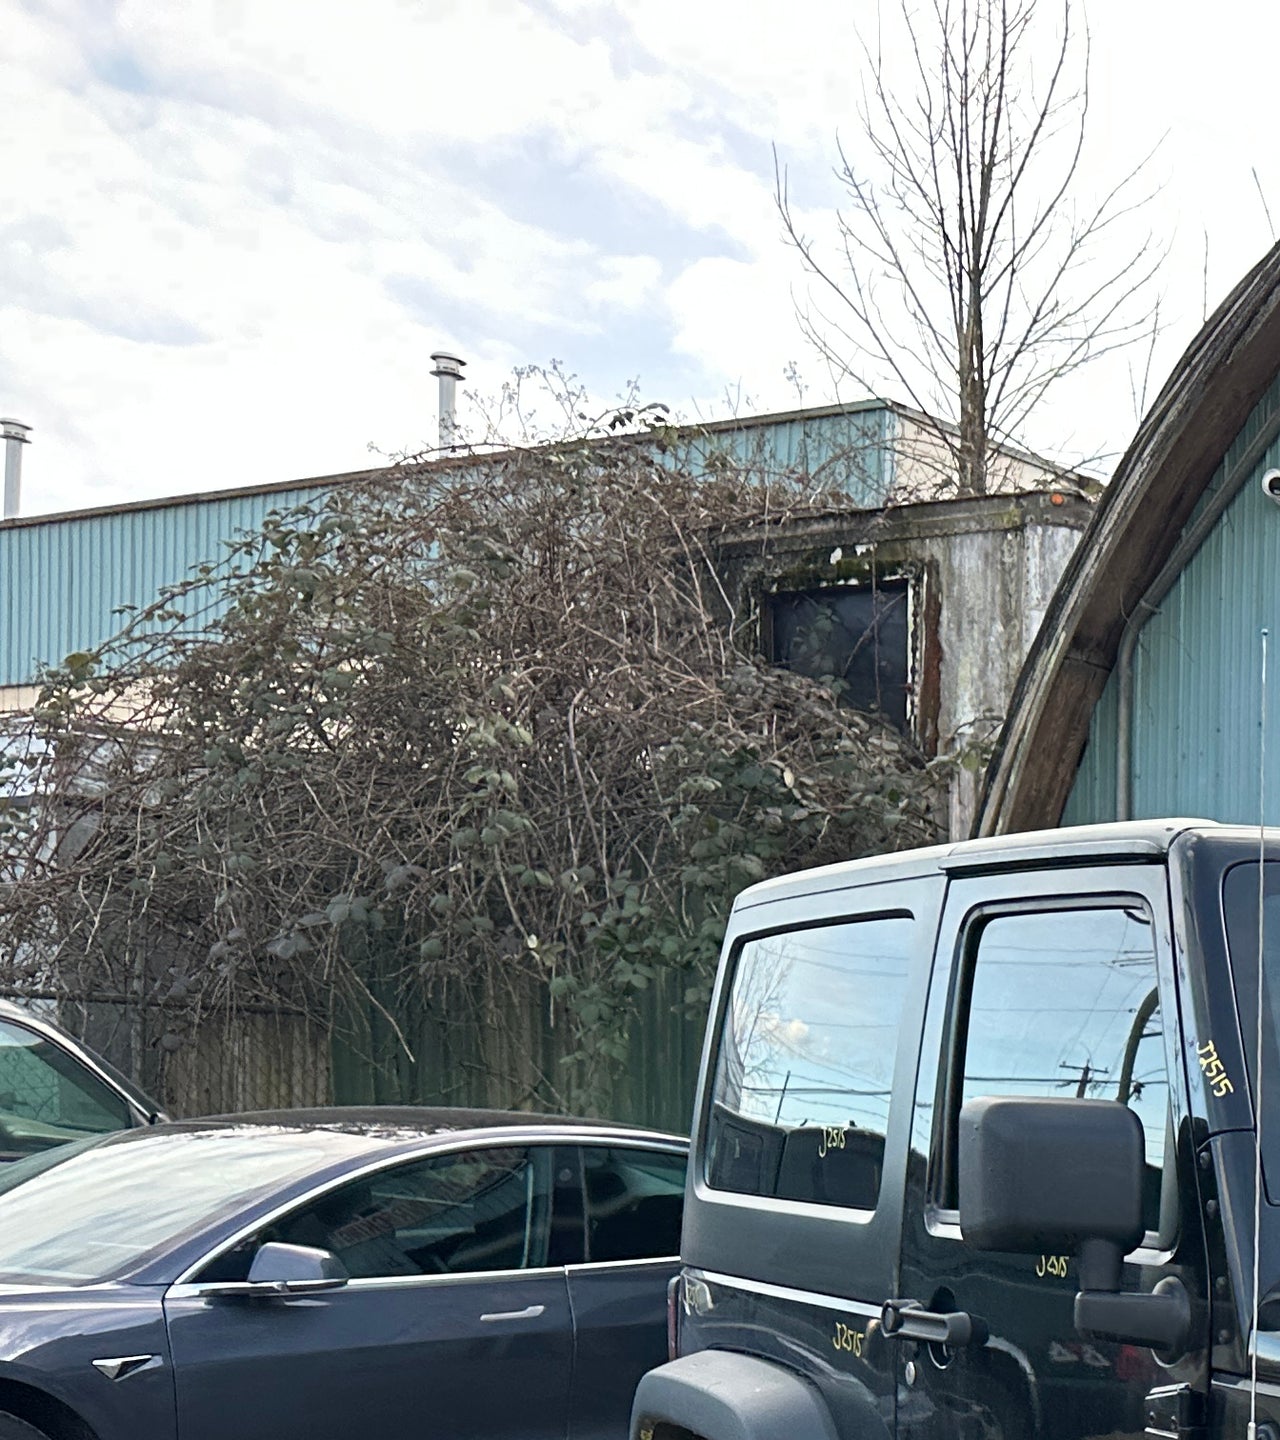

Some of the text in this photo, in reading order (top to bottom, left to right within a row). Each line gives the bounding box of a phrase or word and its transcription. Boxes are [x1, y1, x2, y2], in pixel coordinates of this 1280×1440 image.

[1195, 1039, 1235, 1098] J2515
[818, 1125, 849, 1159] J2515
[832, 1321, 865, 1358] J2515
